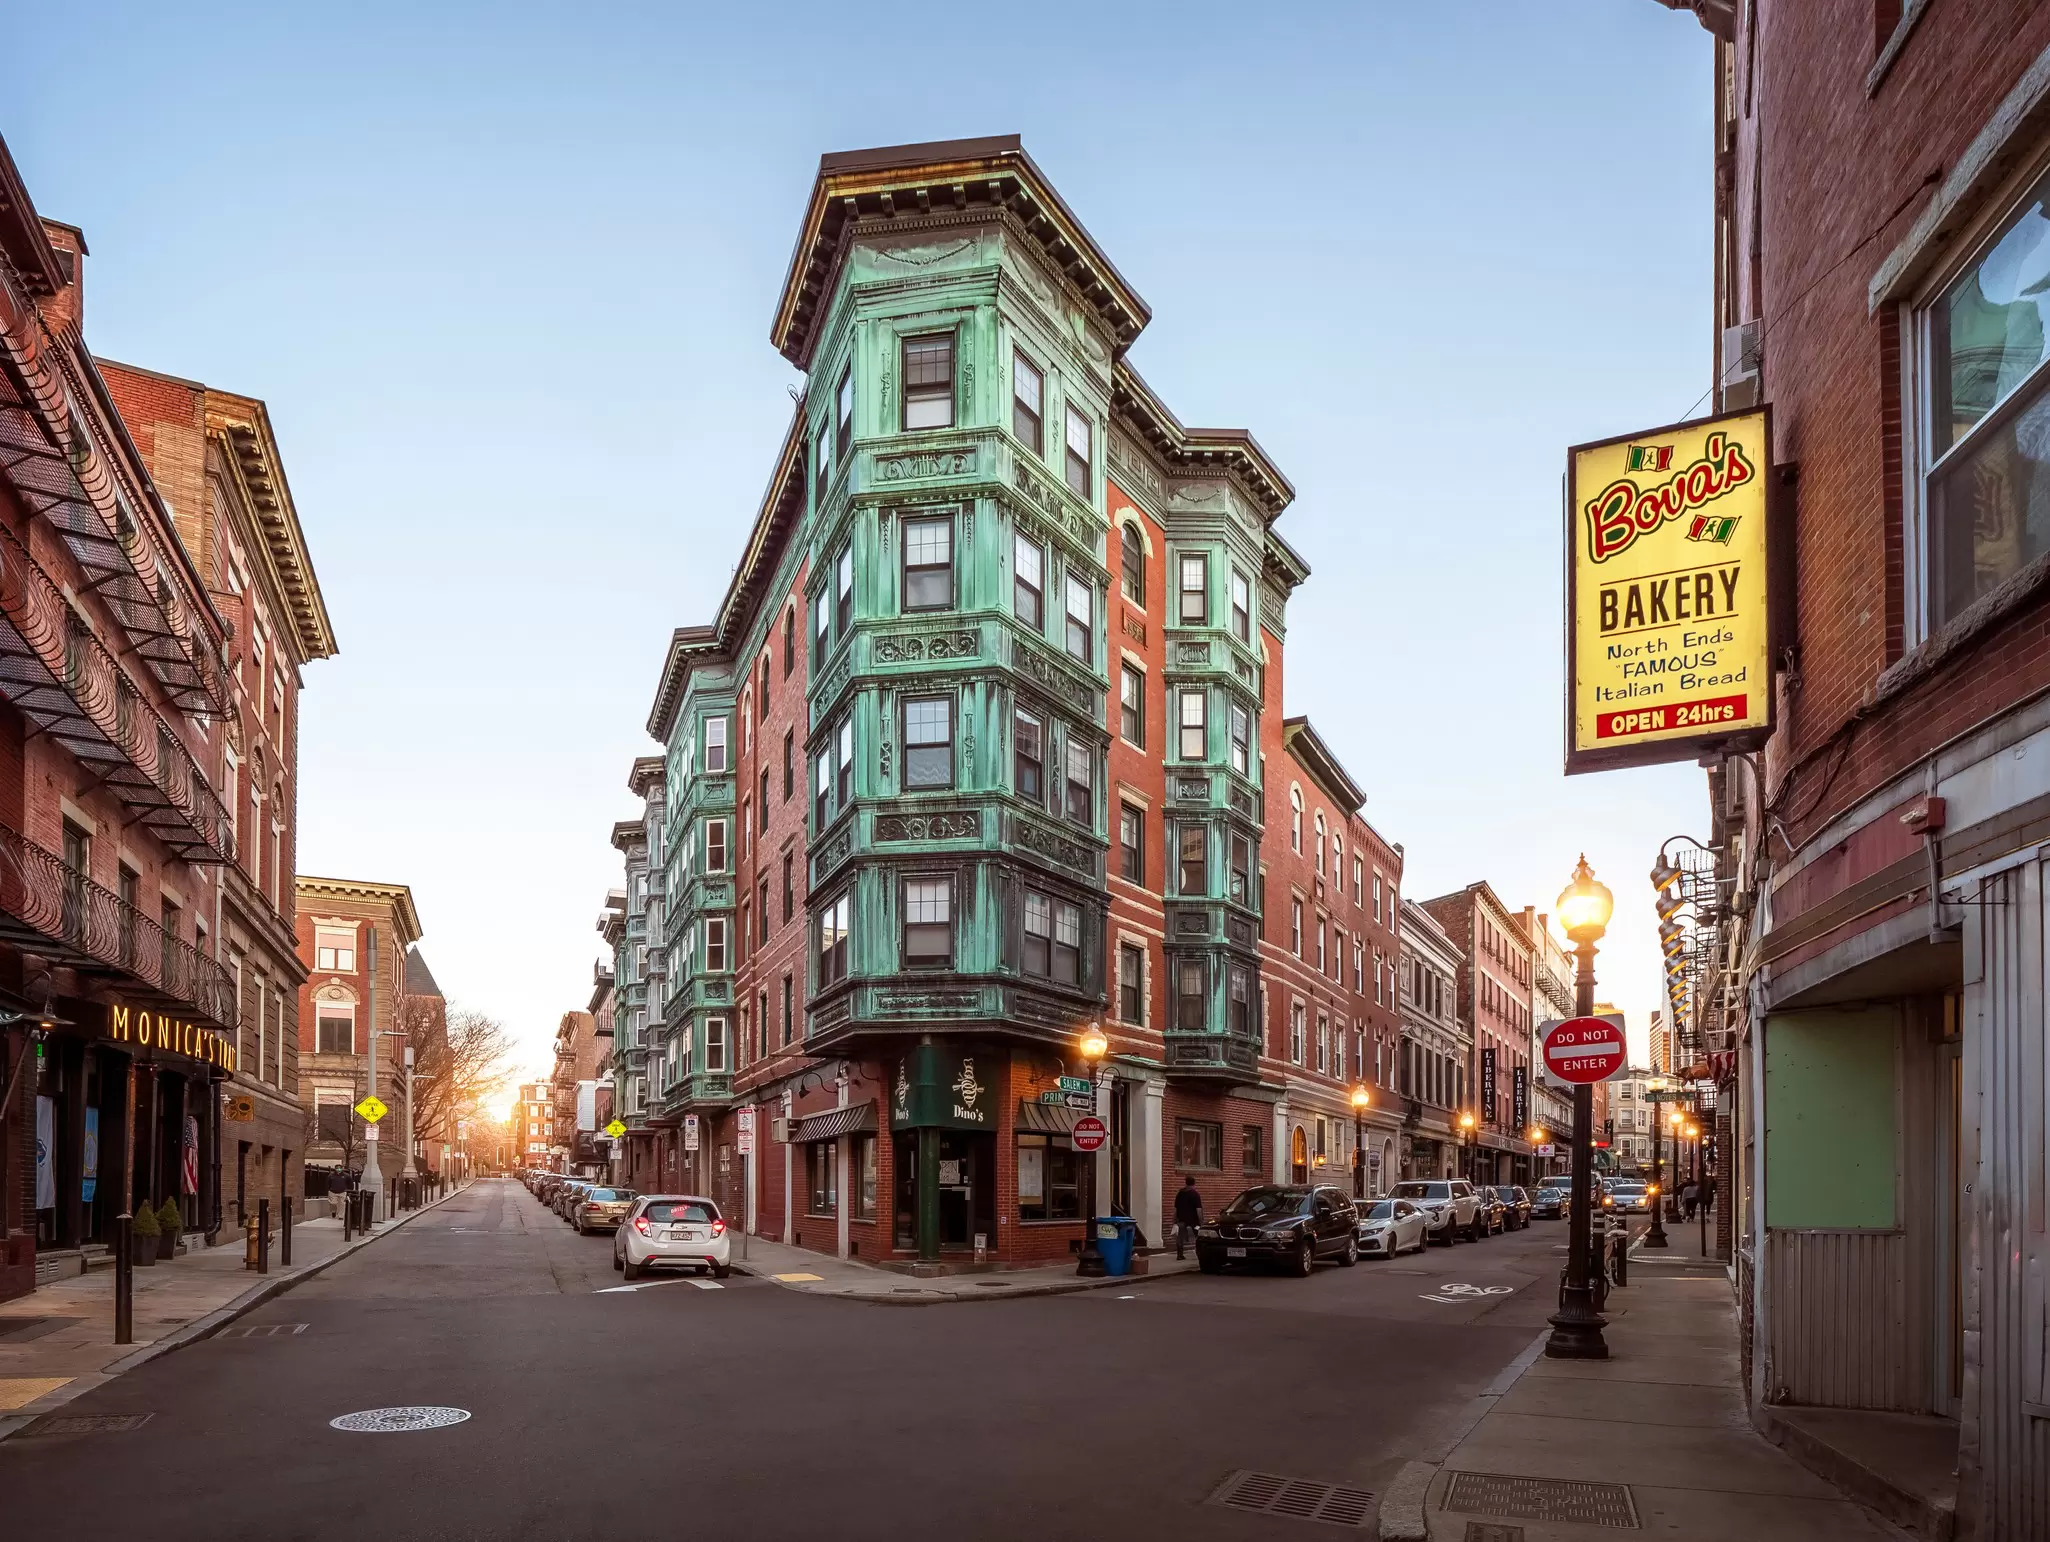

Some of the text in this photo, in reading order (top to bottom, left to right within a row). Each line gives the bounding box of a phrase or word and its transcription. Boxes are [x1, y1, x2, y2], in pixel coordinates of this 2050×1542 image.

[1586, 433, 1753, 562] Bova's
[1600, 566, 1741, 632] BAKERY
[1607, 625, 1734, 660] North End's
[1595, 666, 1747, 702] Italian Bread
[1611, 703, 1734, 734] OPEN 24hrs
[113, 1004, 214, 1063] MONICA'S
[1557, 1029, 1609, 1044] DO NOT
[1563, 1058, 1607, 1071] ENTER
[1063, 1078, 1080, 1090] SALEM
[1484, 1051, 1493, 1119] LIBERTINE
[895, 1107, 909, 1121] Dino's
[953, 1104, 984, 1122] Dino's
